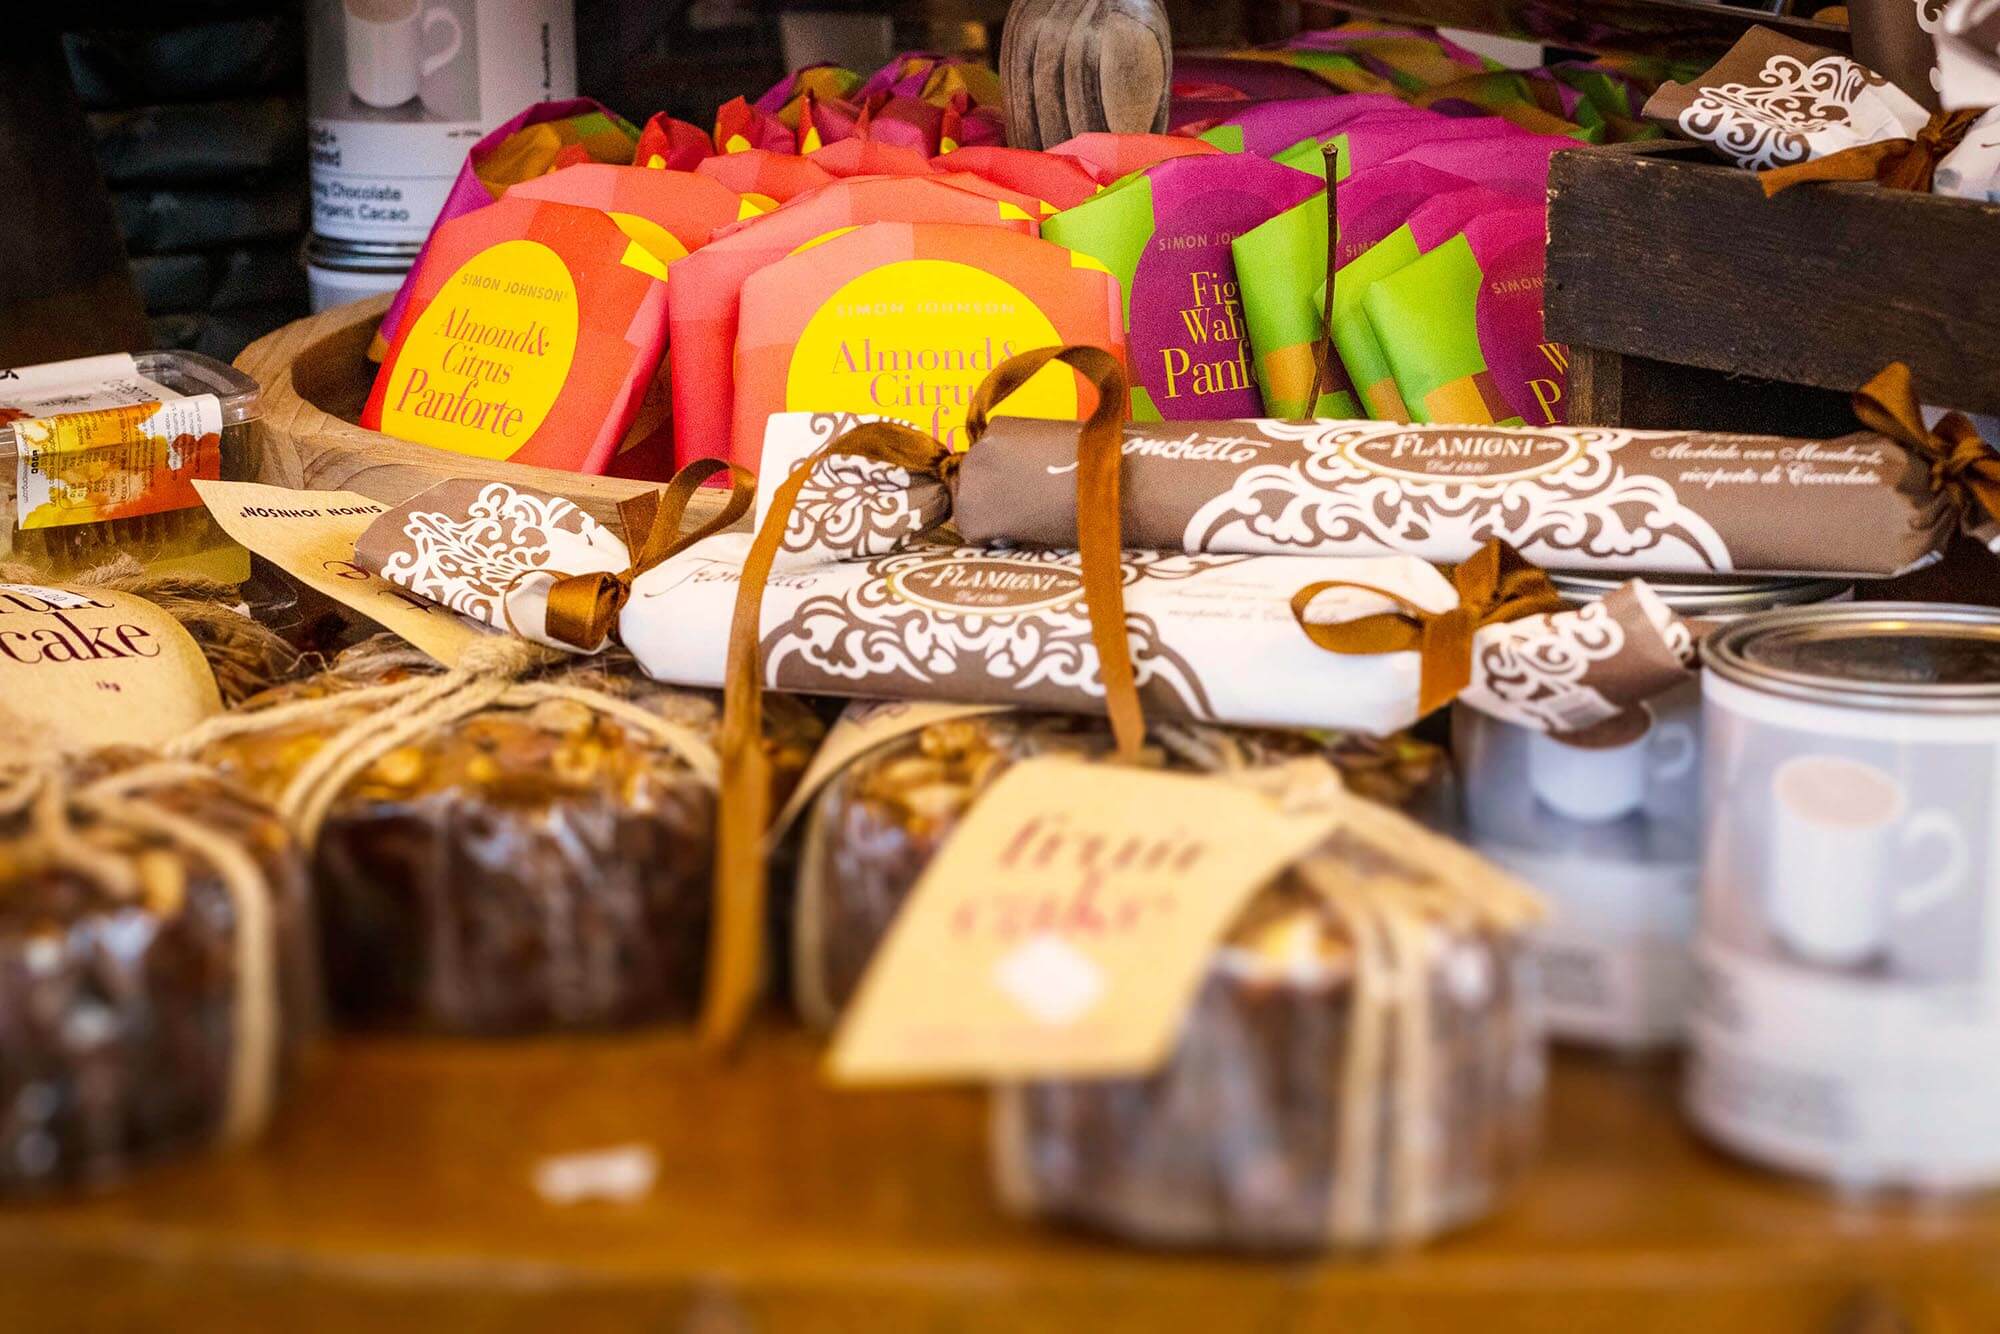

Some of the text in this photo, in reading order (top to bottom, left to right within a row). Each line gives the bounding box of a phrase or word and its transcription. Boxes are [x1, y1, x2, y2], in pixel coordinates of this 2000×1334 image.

[331, 181, 402, 200] Chocolate
[358, 203, 409, 221] Cacao
[1158, 233, 1208, 251] SIMON
[461, 273, 500, 291] SIMON
[836, 301, 1016, 318] SIMON JOHNSON
[1179, 306, 1247, 346] Wal
[442, 341, 514, 384] Citrus
[1159, 341, 1254, 400] Panf
[394, 367, 524, 438] Panforte
[869, 373, 978, 408] Citru
[1391, 433, 1534, 458] FLAMIGNI
[327, 505, 383, 517] SIMON
[929, 564, 1059, 591] FLAMIGNI
[0, 612, 161, 664] cake
